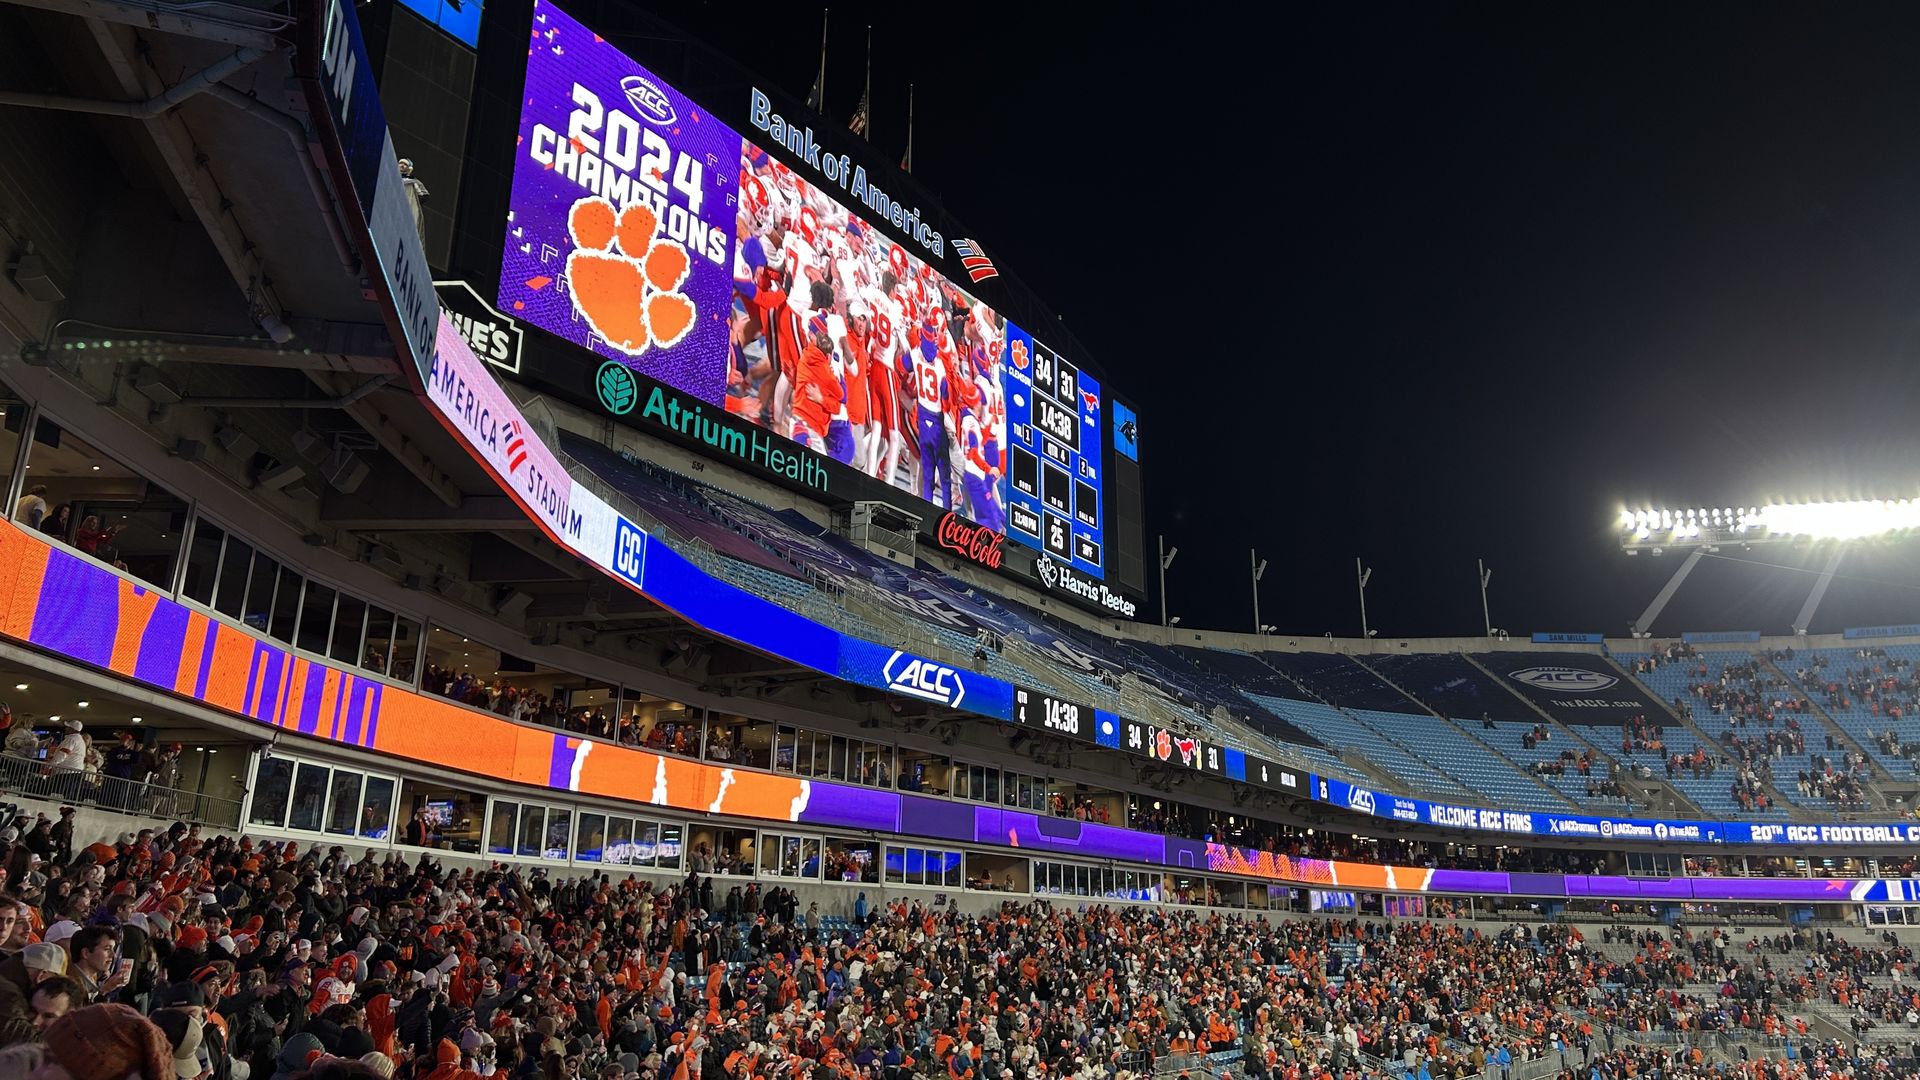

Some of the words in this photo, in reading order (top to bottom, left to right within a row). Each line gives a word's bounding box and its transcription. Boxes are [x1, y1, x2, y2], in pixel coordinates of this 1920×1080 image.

[629, 84, 670, 119] ACC
[567, 81, 704, 215] 2024
[750, 86, 821, 171] Bank
[823, 153, 850, 190] of
[851, 164, 945, 259] America
[1008, 366, 1031, 387] CLEMSON
[1035, 353, 1053, 386] 34
[394, 238, 422, 337] BANK
[420, 315, 433, 364] OF
[430, 350, 497, 453] AMERICA
[528, 464, 583, 540] STADIUM
[916, 363, 939, 403] 13
[1061, 370, 1075, 401] 31
[1040, 401, 1072, 441] 14:38
[643, 386, 746, 458] Atrium
[751, 430, 828, 492] Health
[1025, 429, 1031, 442] 1
[1060, 449, 1066, 462] 4
[1081, 461, 1086, 473] 2
[1051, 524, 1064, 550] 25
[1059, 567, 1099, 601] Harris
[1100, 584, 1136, 617] Teeter
[896, 659, 955, 696] ACC
[1531, 673, 1597, 681] ACC
[1019, 706, 1026, 723] 4
[1044, 697, 1079, 734] 14:38
[1128, 724, 1142, 749] 34
[1208, 747, 1219, 770] 31
[1320, 781, 1328, 799] 25
[1352, 788, 1371, 808] ACC
[1429, 805, 1478, 827] WELCOME
[1480, 809, 1501, 830] ACC
[1504, 812, 1532, 831] FANS
[1751, 825, 1783, 841] 20TH
[1787, 826, 1818, 841] ACC
[1820, 826, 1905, 842] FOOTBALL
